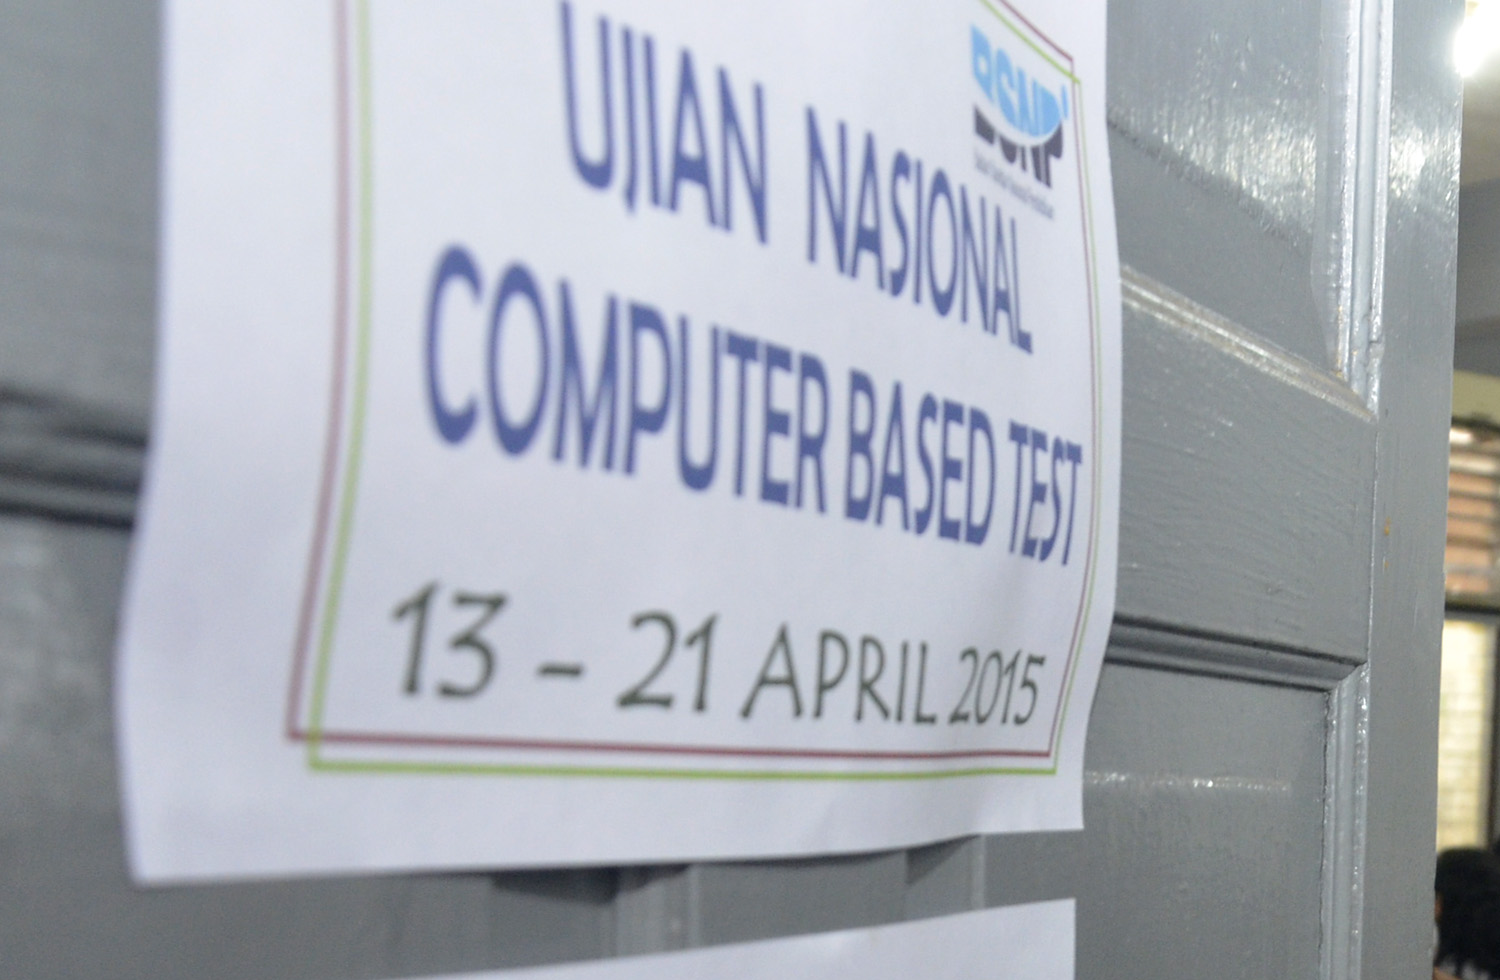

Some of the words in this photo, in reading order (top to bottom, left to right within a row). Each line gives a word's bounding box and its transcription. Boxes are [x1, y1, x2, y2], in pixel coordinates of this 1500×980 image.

[560, 0, 769, 246] UJIAN
[805, 107, 1033, 356] NASIONAL
[422, 244, 830, 516] COMPUTER
[842, 368, 998, 549] BASED
[1007, 419, 1084, 568] TEST
[390, 580, 510, 702] 13
[614, 609, 719, 715] 21
[738, 622, 941, 729] APRIL
[947, 646, 1048, 729] 2015
